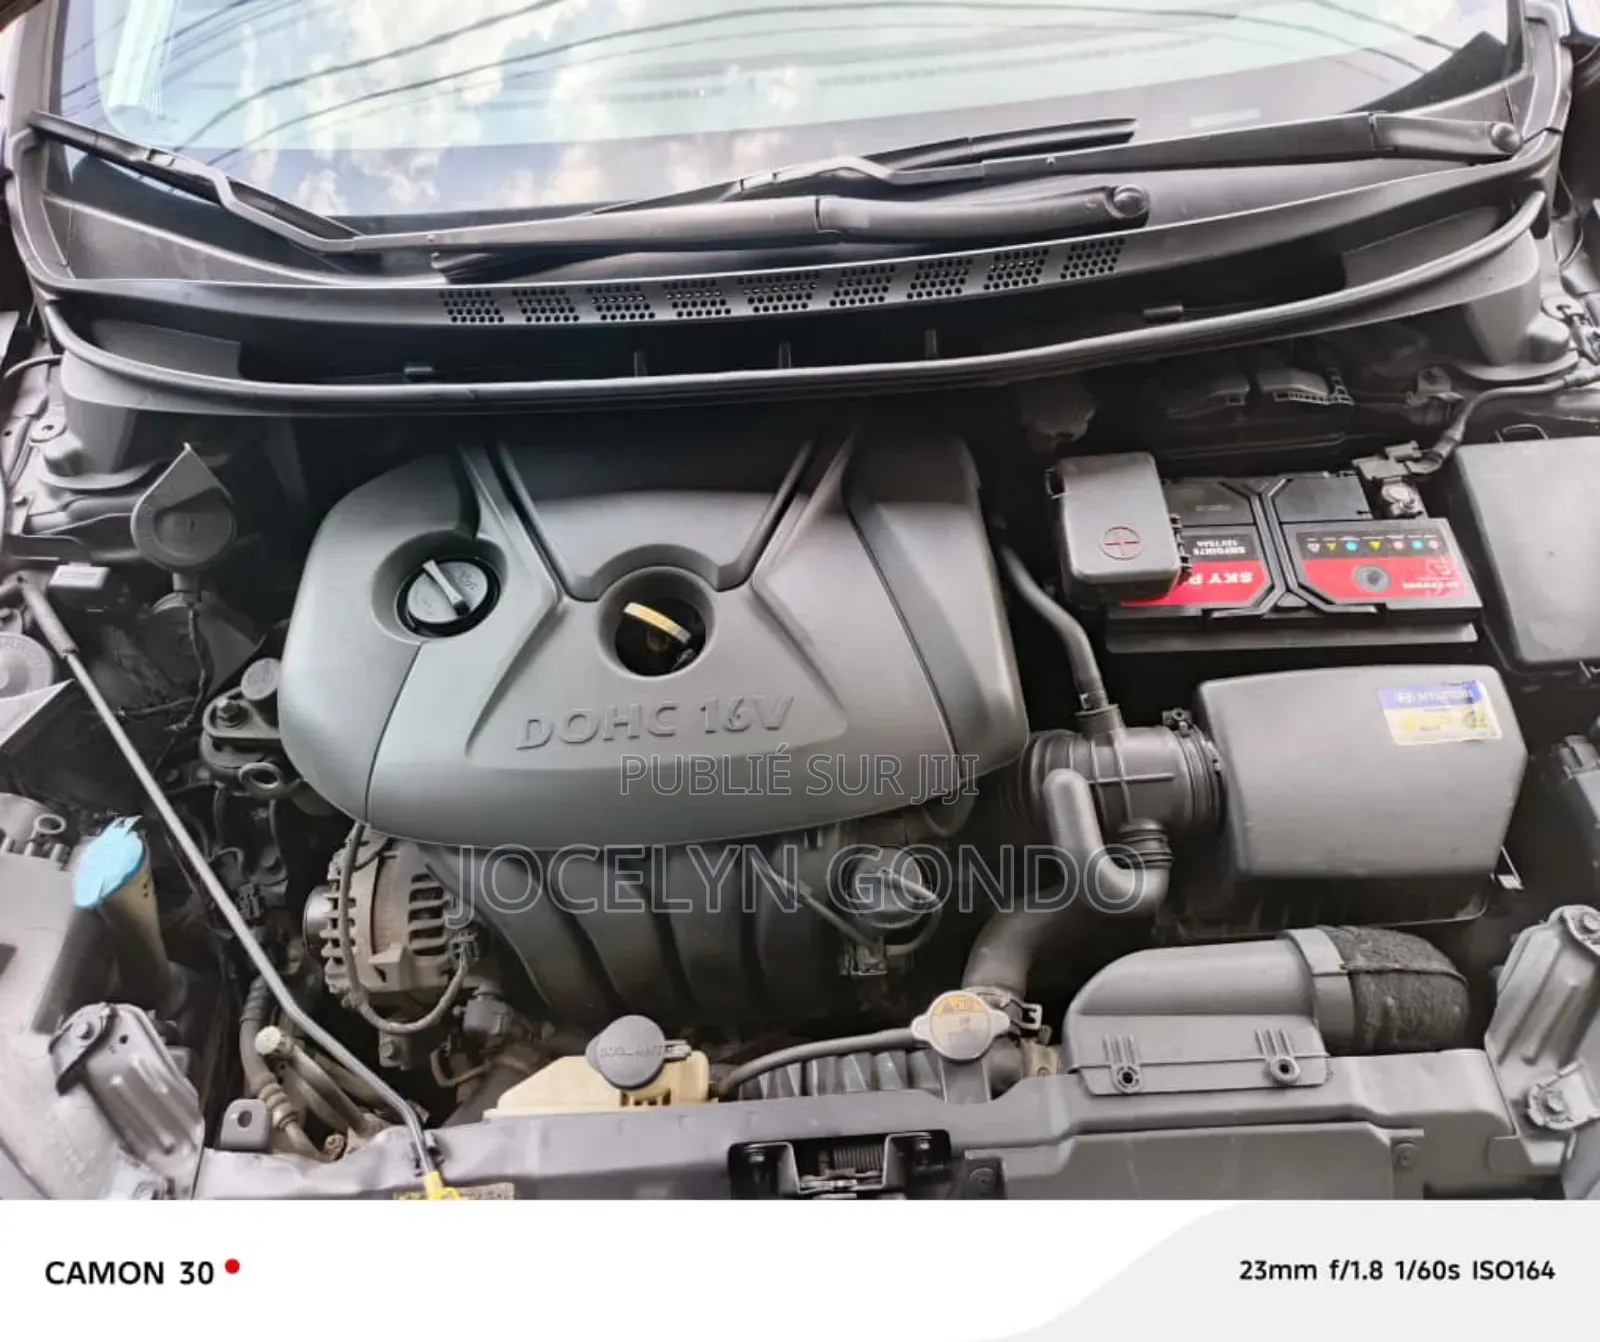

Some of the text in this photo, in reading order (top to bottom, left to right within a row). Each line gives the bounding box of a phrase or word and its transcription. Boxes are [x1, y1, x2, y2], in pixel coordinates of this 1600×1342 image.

[1208, 571, 1253, 584] SKY
[516, 696, 795, 751] DOHC 16V
